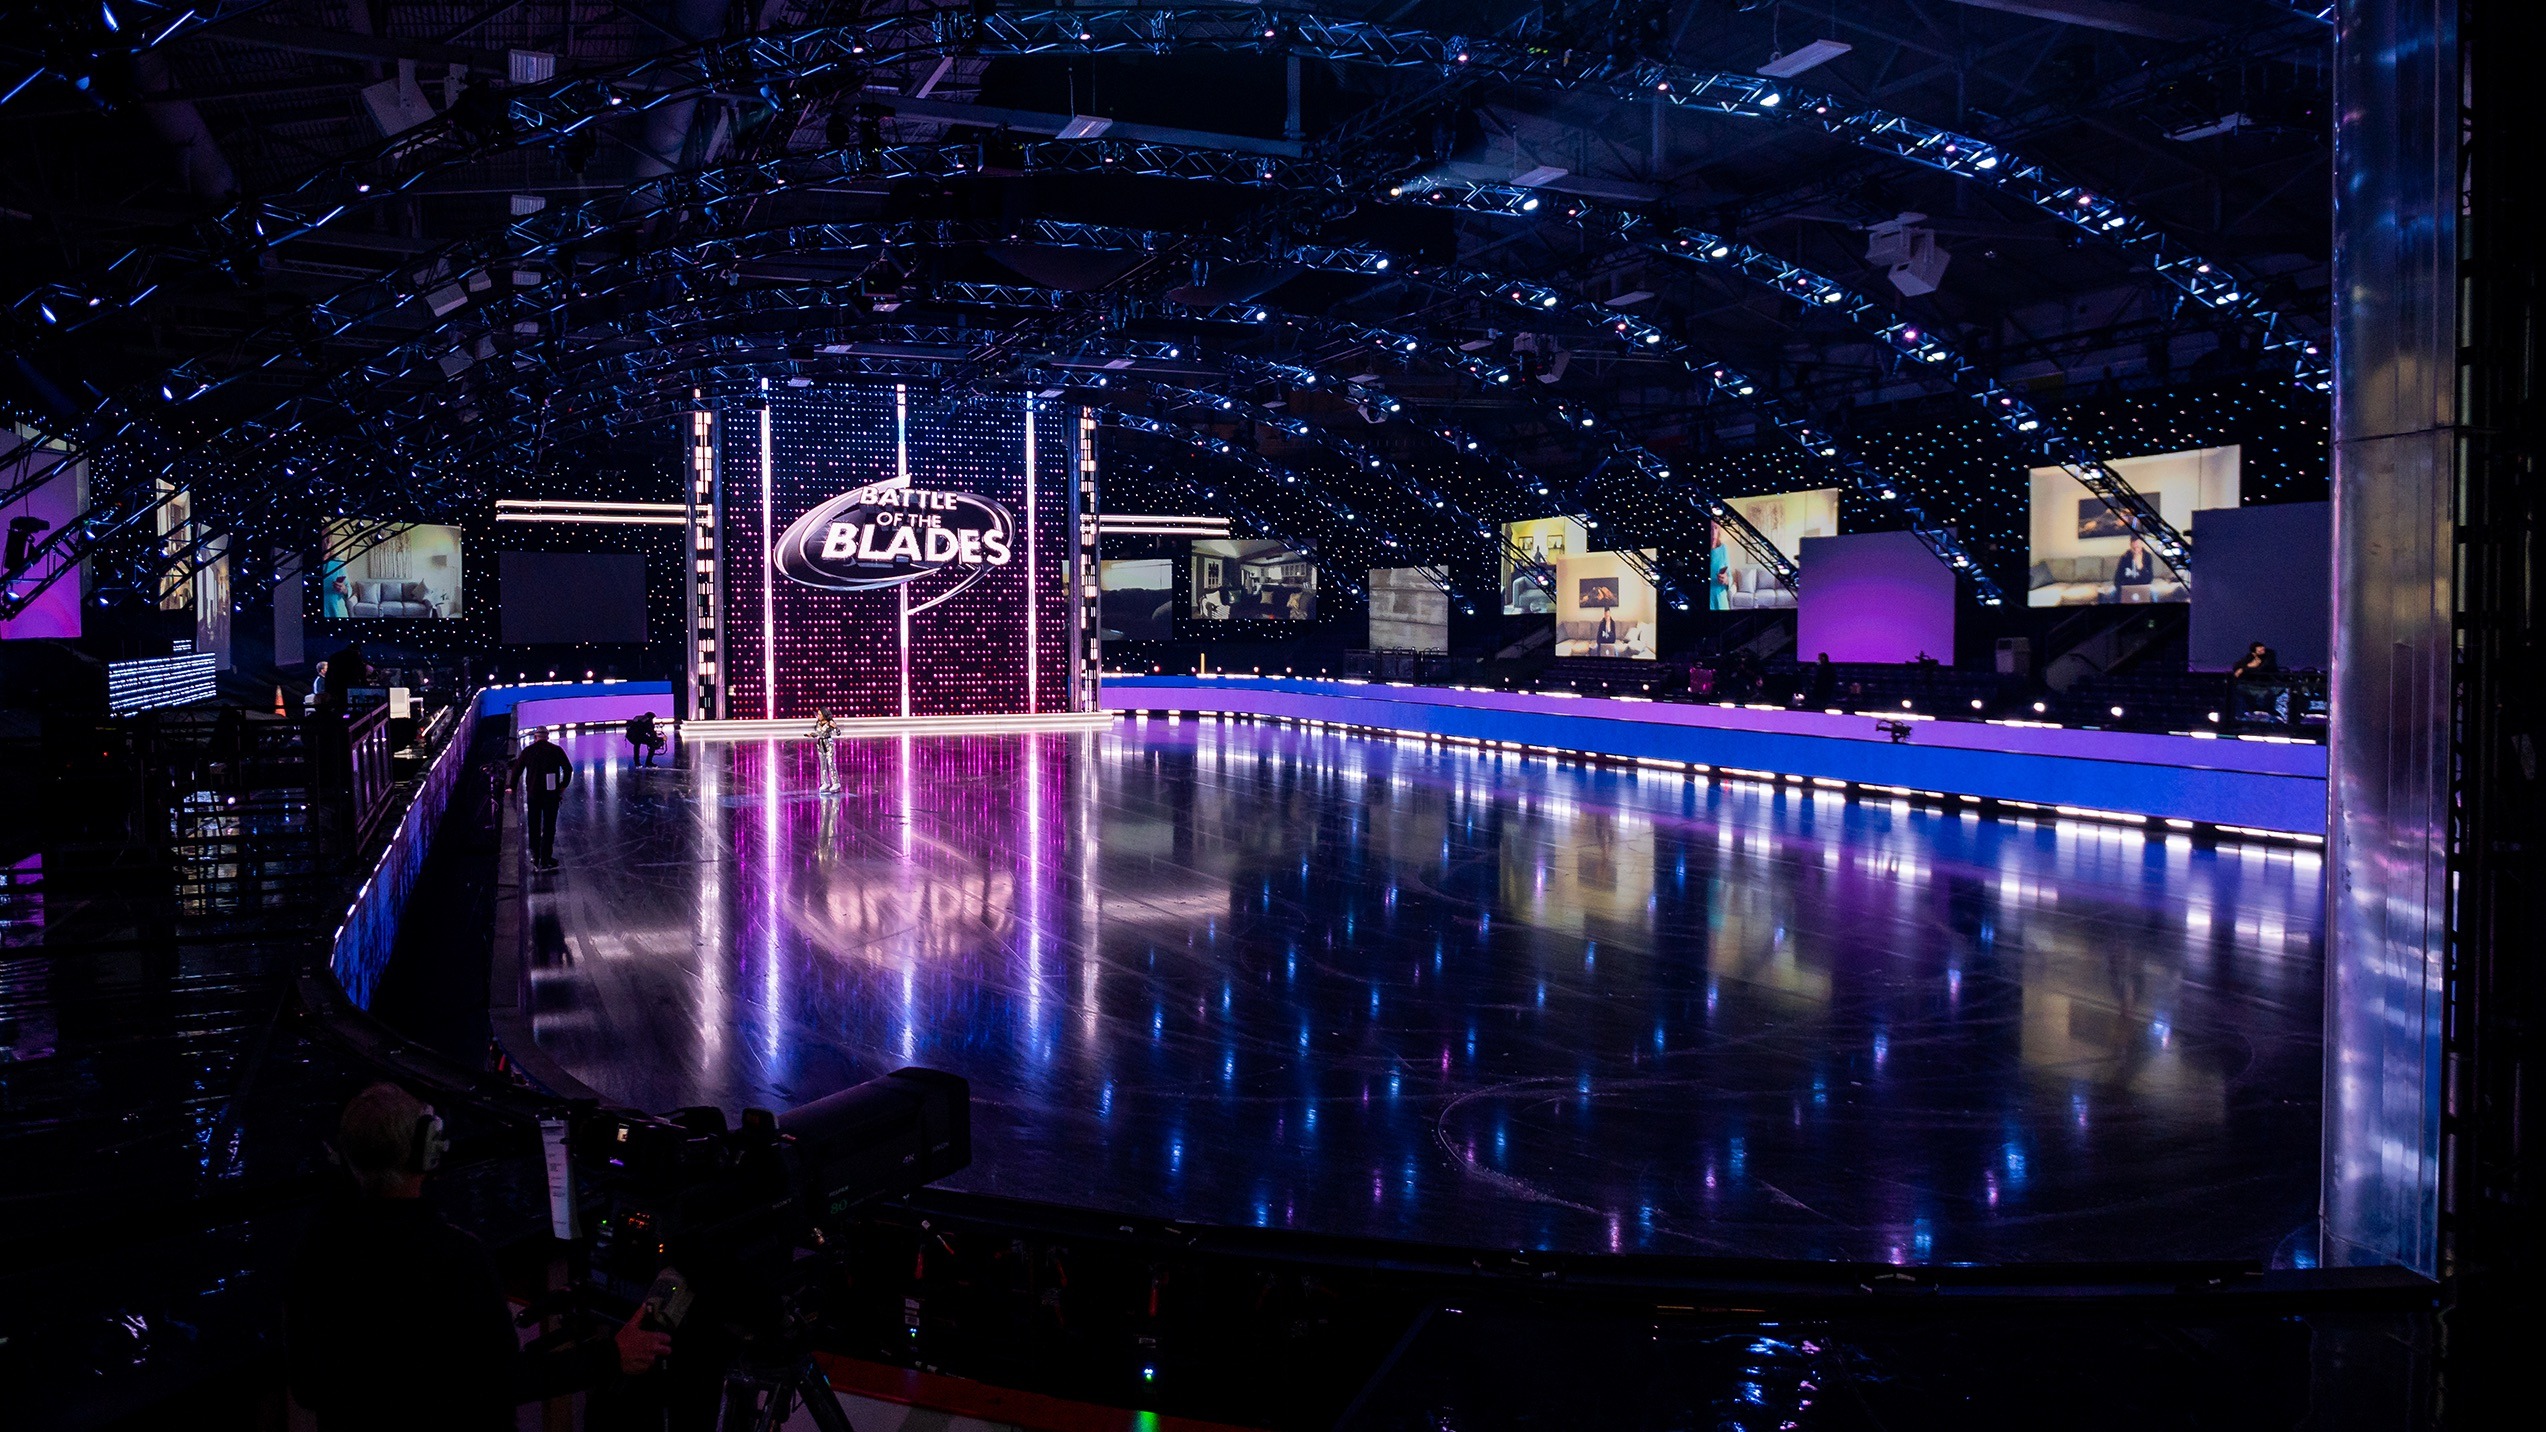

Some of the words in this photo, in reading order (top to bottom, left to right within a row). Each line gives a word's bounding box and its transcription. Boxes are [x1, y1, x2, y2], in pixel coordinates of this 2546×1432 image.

[860, 486, 957, 511] BATTLE
[876, 511, 902, 527] OF
[908, 513, 941, 528] THE
[821, 521, 1011, 565] BLADES
[830, 1198, 848, 1215] 80
